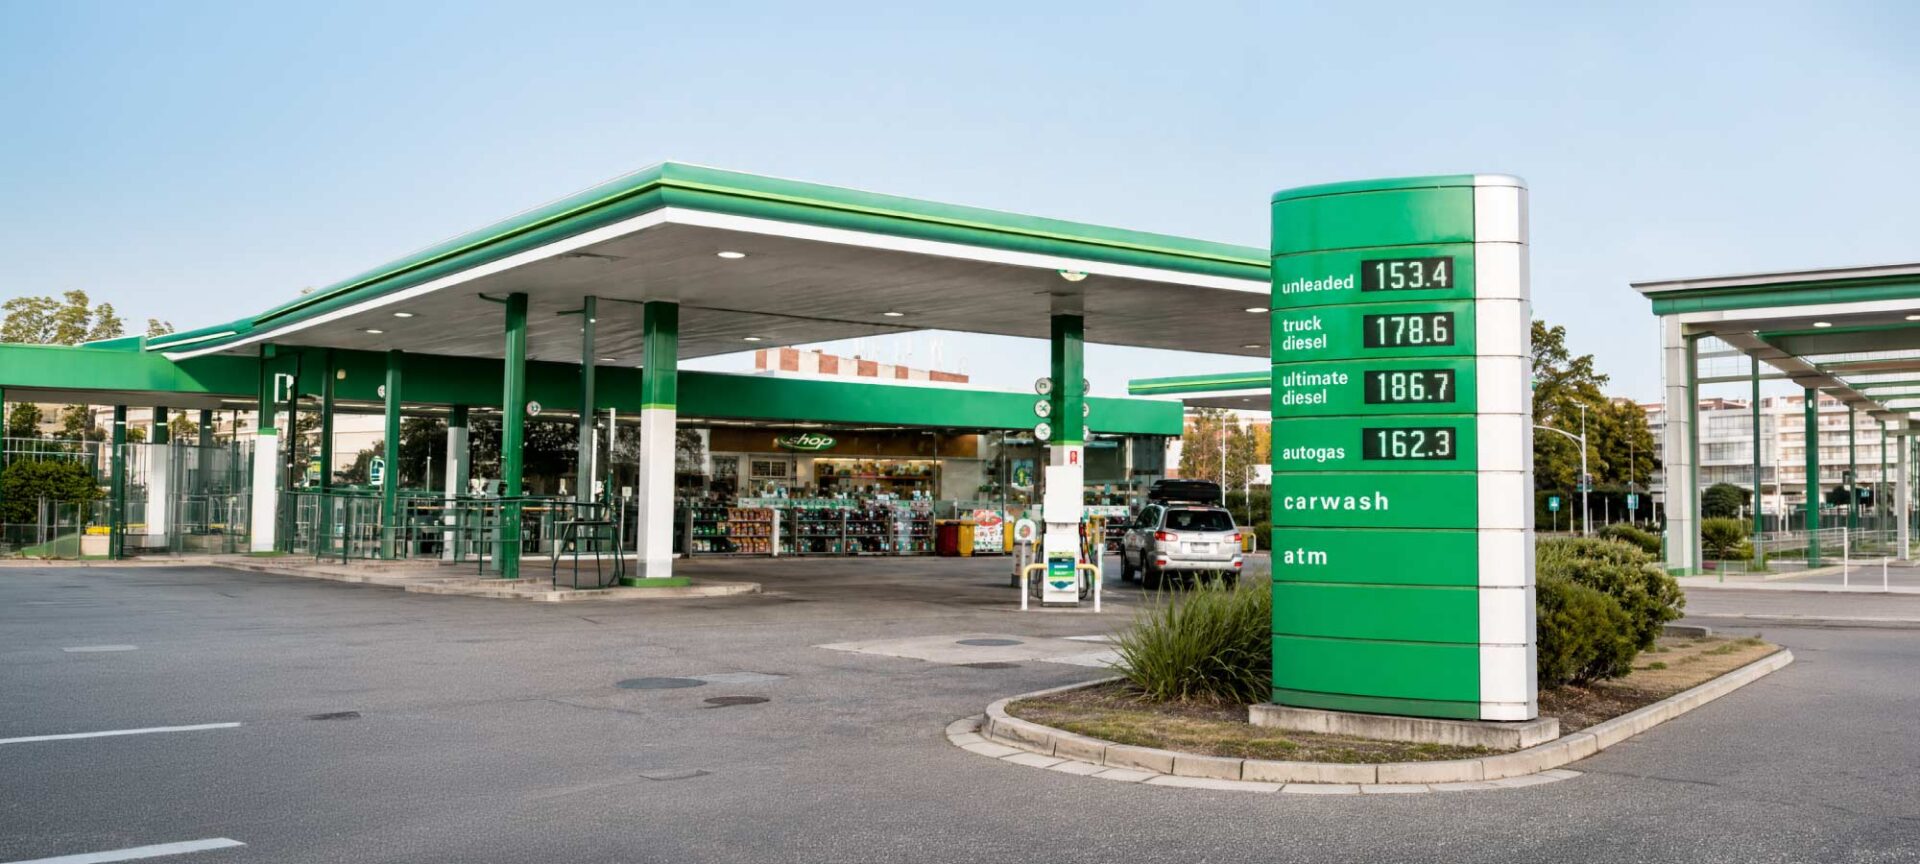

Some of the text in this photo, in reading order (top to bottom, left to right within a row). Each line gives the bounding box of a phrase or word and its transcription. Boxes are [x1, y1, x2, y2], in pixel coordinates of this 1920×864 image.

[1282, 275, 1354, 294] unleaded
[1376, 261, 1447, 290] 153.4
[1283, 316, 1322, 332] truck
[1376, 316, 1447, 345] 178.6
[1282, 334, 1327, 351] diesel
[1282, 371, 1349, 387] ultimate
[1377, 373, 1448, 401] 186.7
[1282, 389, 1327, 405] diesel
[1378, 430, 1450, 458] 162.3
[1282, 446, 1345, 463] autogas
[1284, 491, 1389, 511] carwash
[1284, 548, 1327, 565] atm
